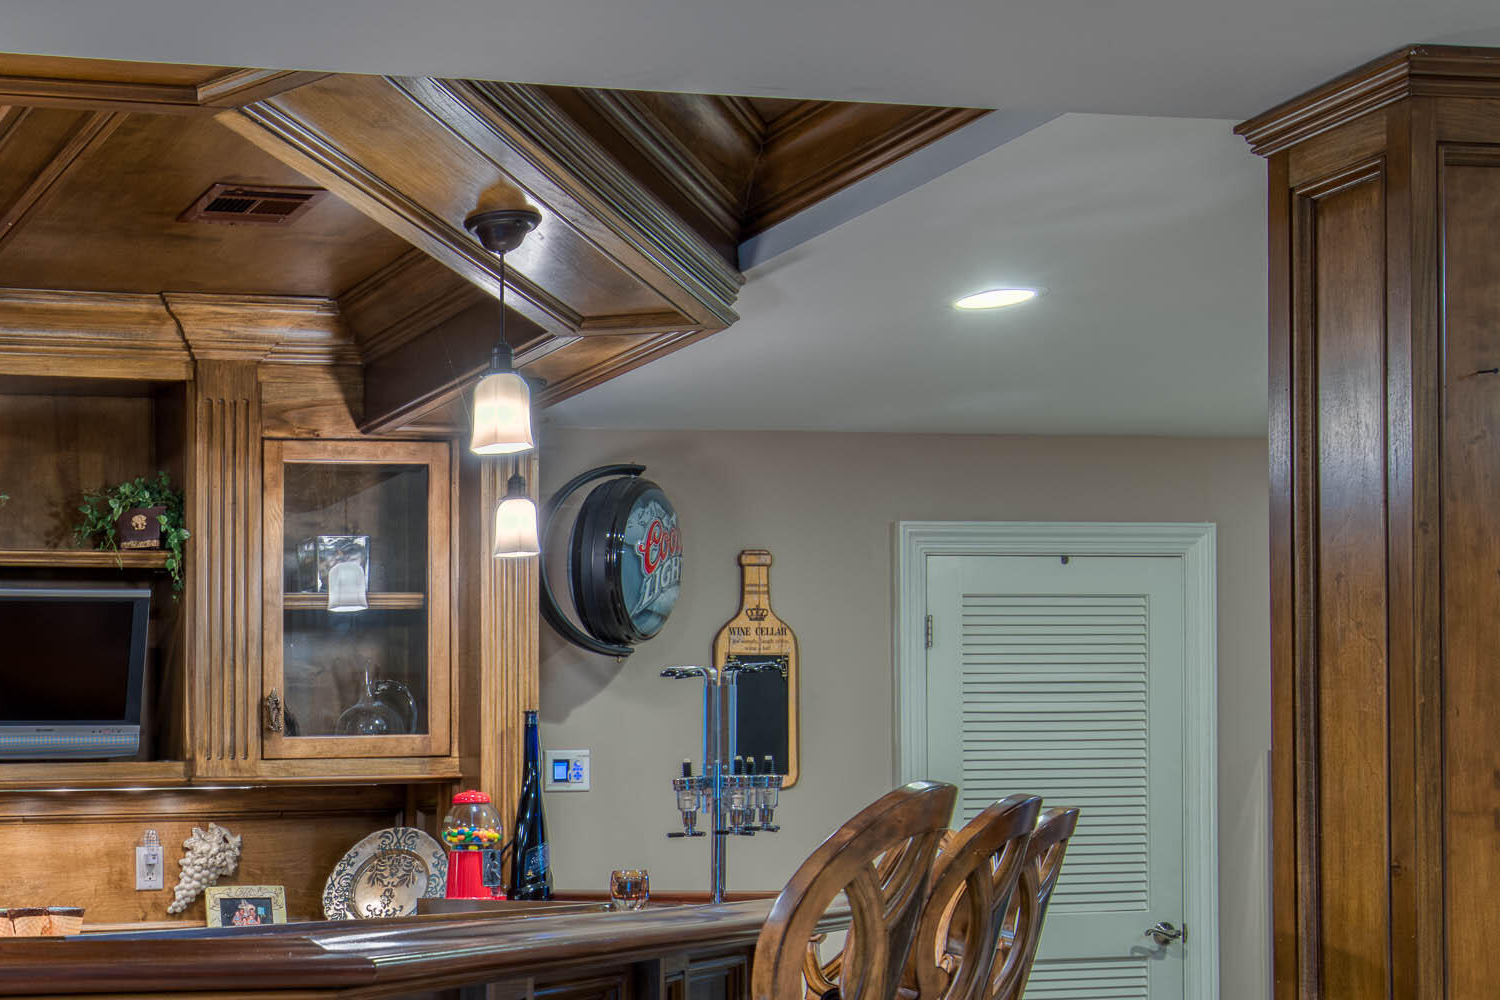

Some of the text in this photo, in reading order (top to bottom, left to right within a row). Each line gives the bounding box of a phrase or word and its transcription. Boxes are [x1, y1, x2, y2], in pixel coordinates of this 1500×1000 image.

[638, 519, 684, 575] Coo
[729, 626, 787, 636] WINE CELLAR
